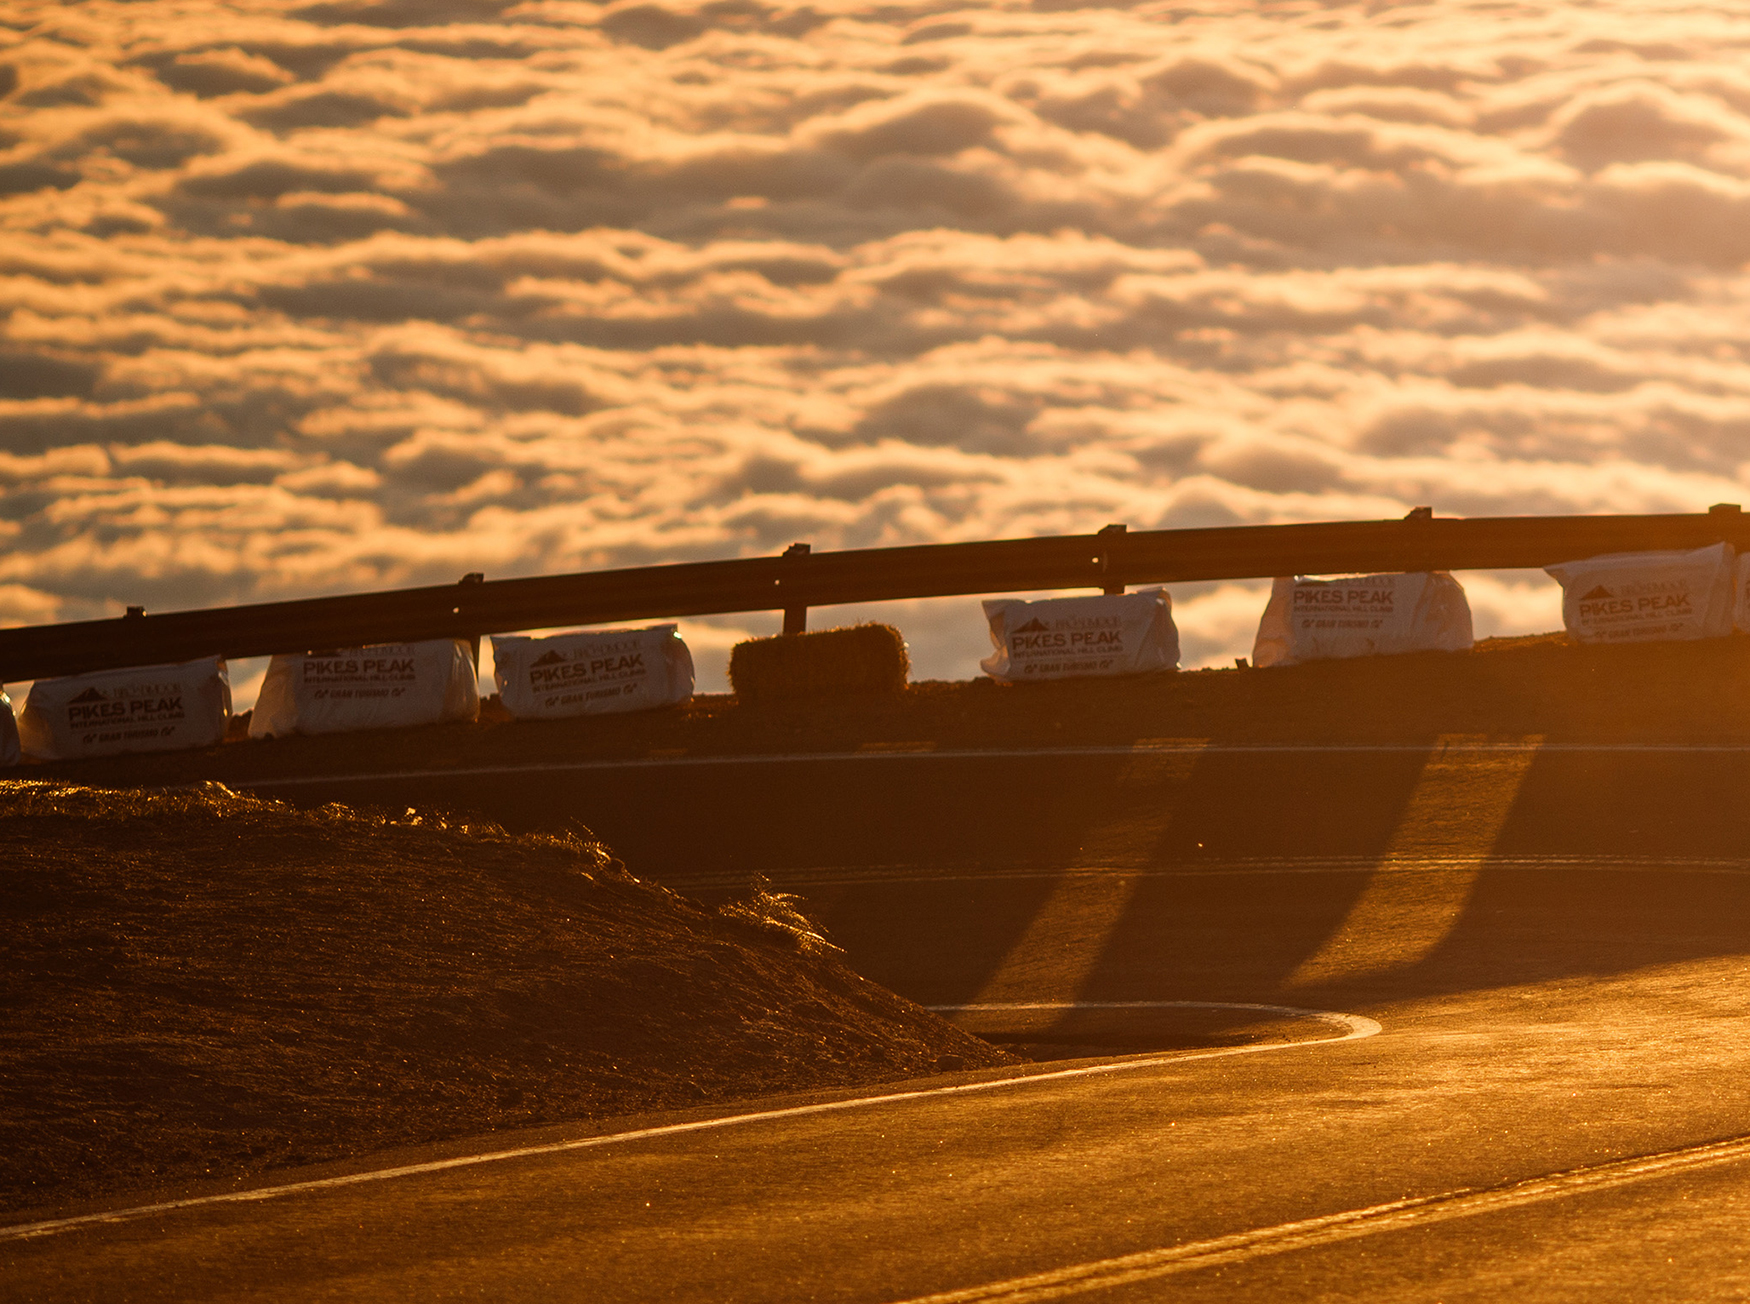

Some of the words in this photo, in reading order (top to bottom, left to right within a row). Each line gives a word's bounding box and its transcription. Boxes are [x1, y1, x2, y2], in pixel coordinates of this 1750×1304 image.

[1294, 590, 1343, 603] PIKES
[1348, 590, 1393, 604] PEAK
[1579, 600, 1633, 617] PIKES
[1638, 593, 1690, 611] PEAK
[1012, 633, 1067, 649] PIKES
[1071, 631, 1122, 645] PEAK
[1014, 649, 1075, 659] INTERNATIONAL
[304, 660, 358, 674] PIKES
[364, 659, 414, 672] PEAK
[530, 663, 586, 683] PIKES
[591, 653, 643, 673] PEAK
[304, 675, 367, 683] INTERNATIONAL
[533, 677, 597, 693] INTERNATIONAL
[600, 673, 616, 681] HILL
[69, 702, 125, 720] PIKES
[130, 697, 183, 714] PEAK
[71, 717, 135, 729] INTERNATIONAL
